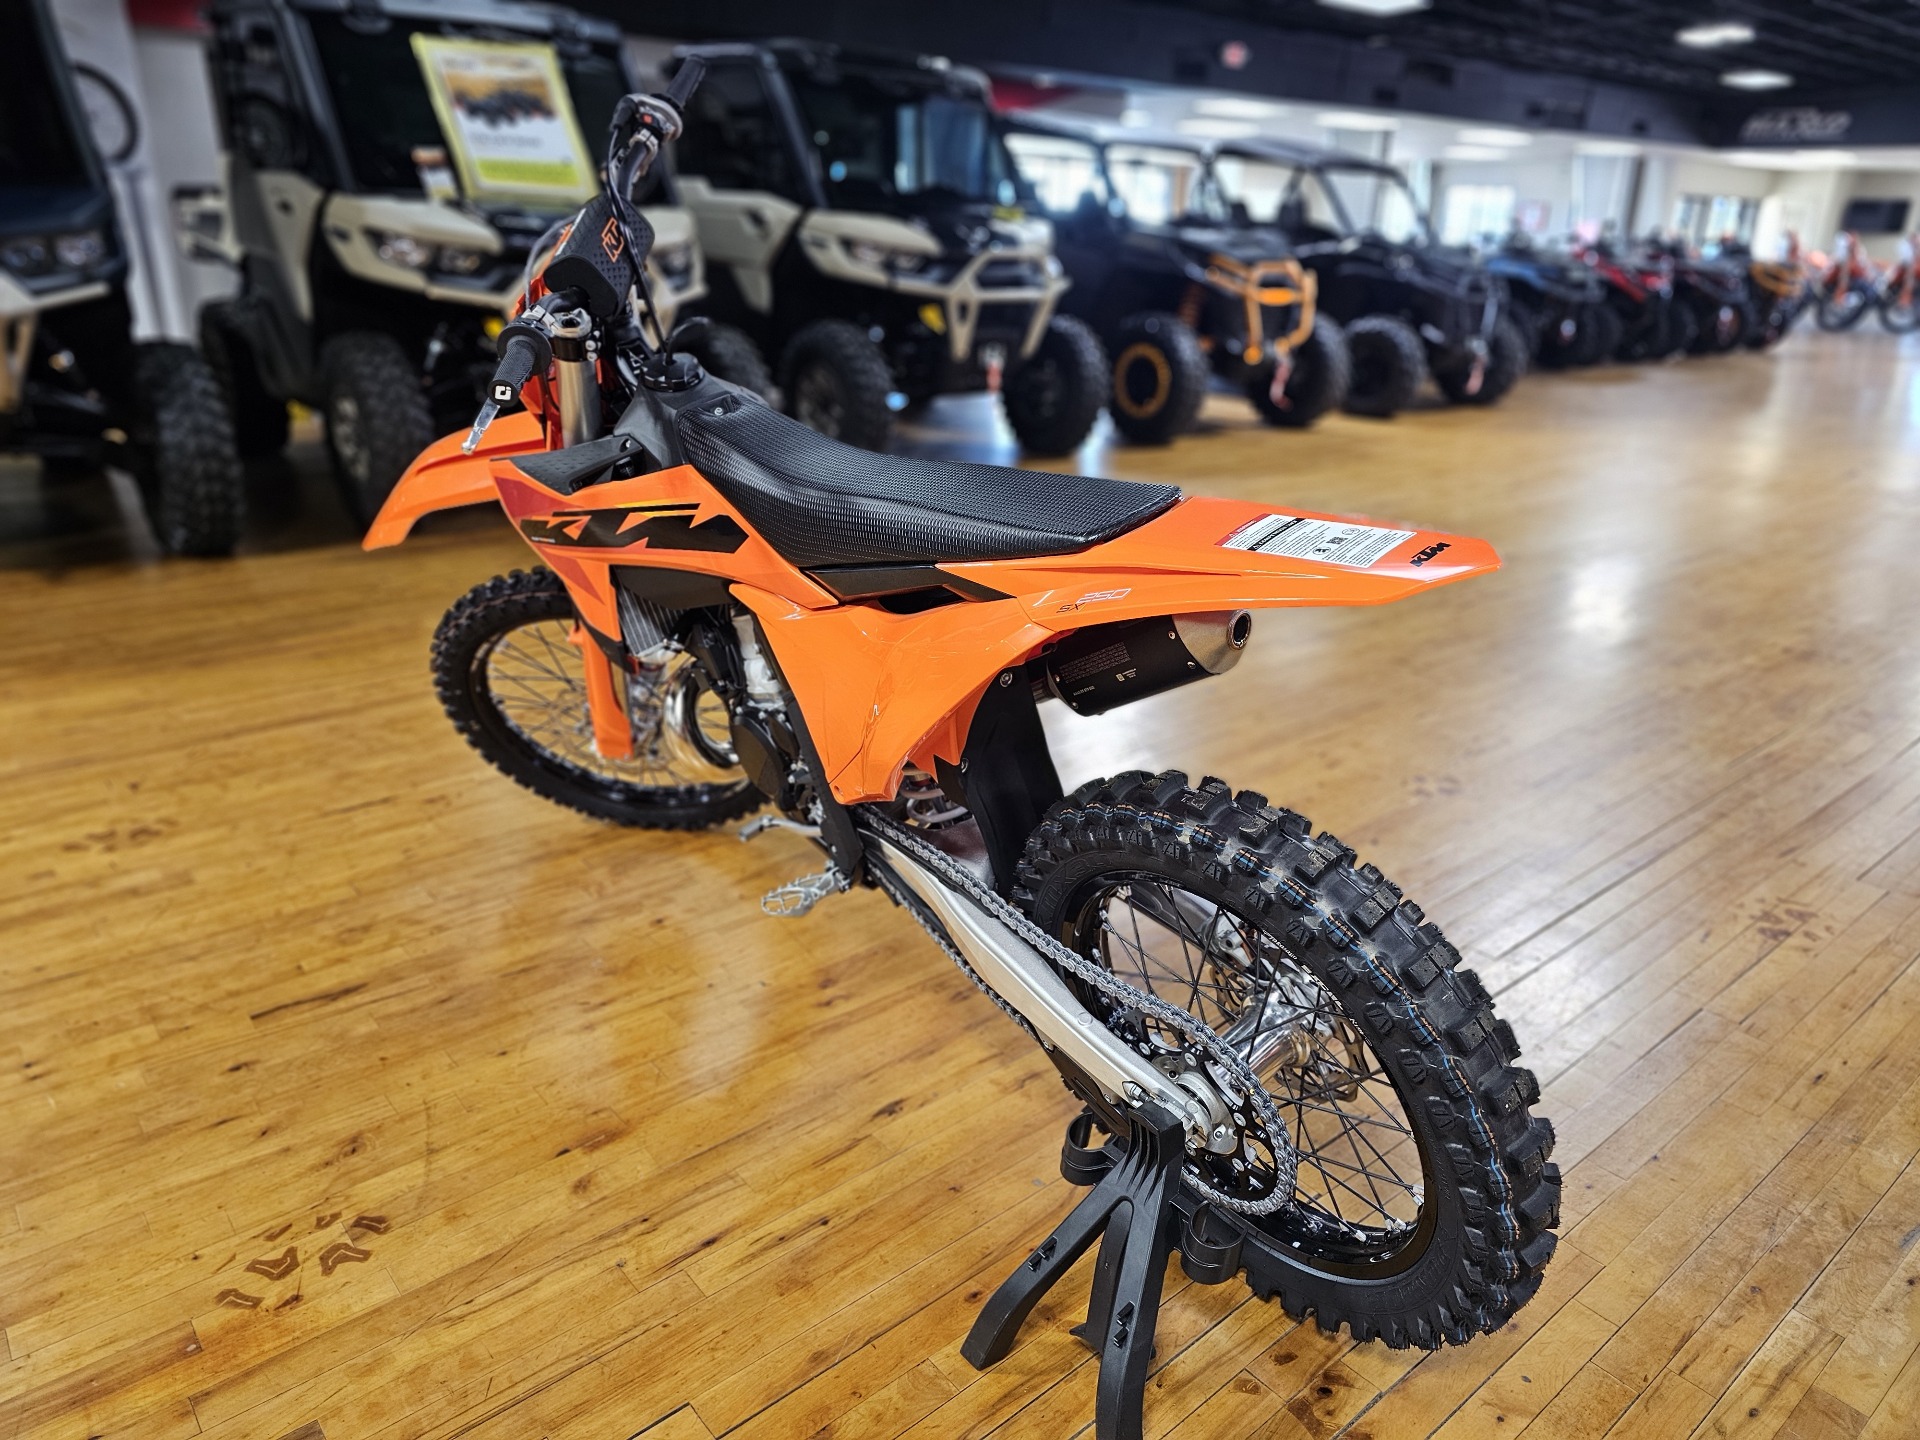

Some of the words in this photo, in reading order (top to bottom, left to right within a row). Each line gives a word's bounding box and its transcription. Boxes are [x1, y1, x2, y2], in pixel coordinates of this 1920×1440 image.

[601, 216, 625, 264] KT
[519, 502, 751, 555] KTM
[1409, 542, 1452, 567] KTM
[1056, 603, 1086, 613] SX
[1075, 588, 1132, 604] 250
